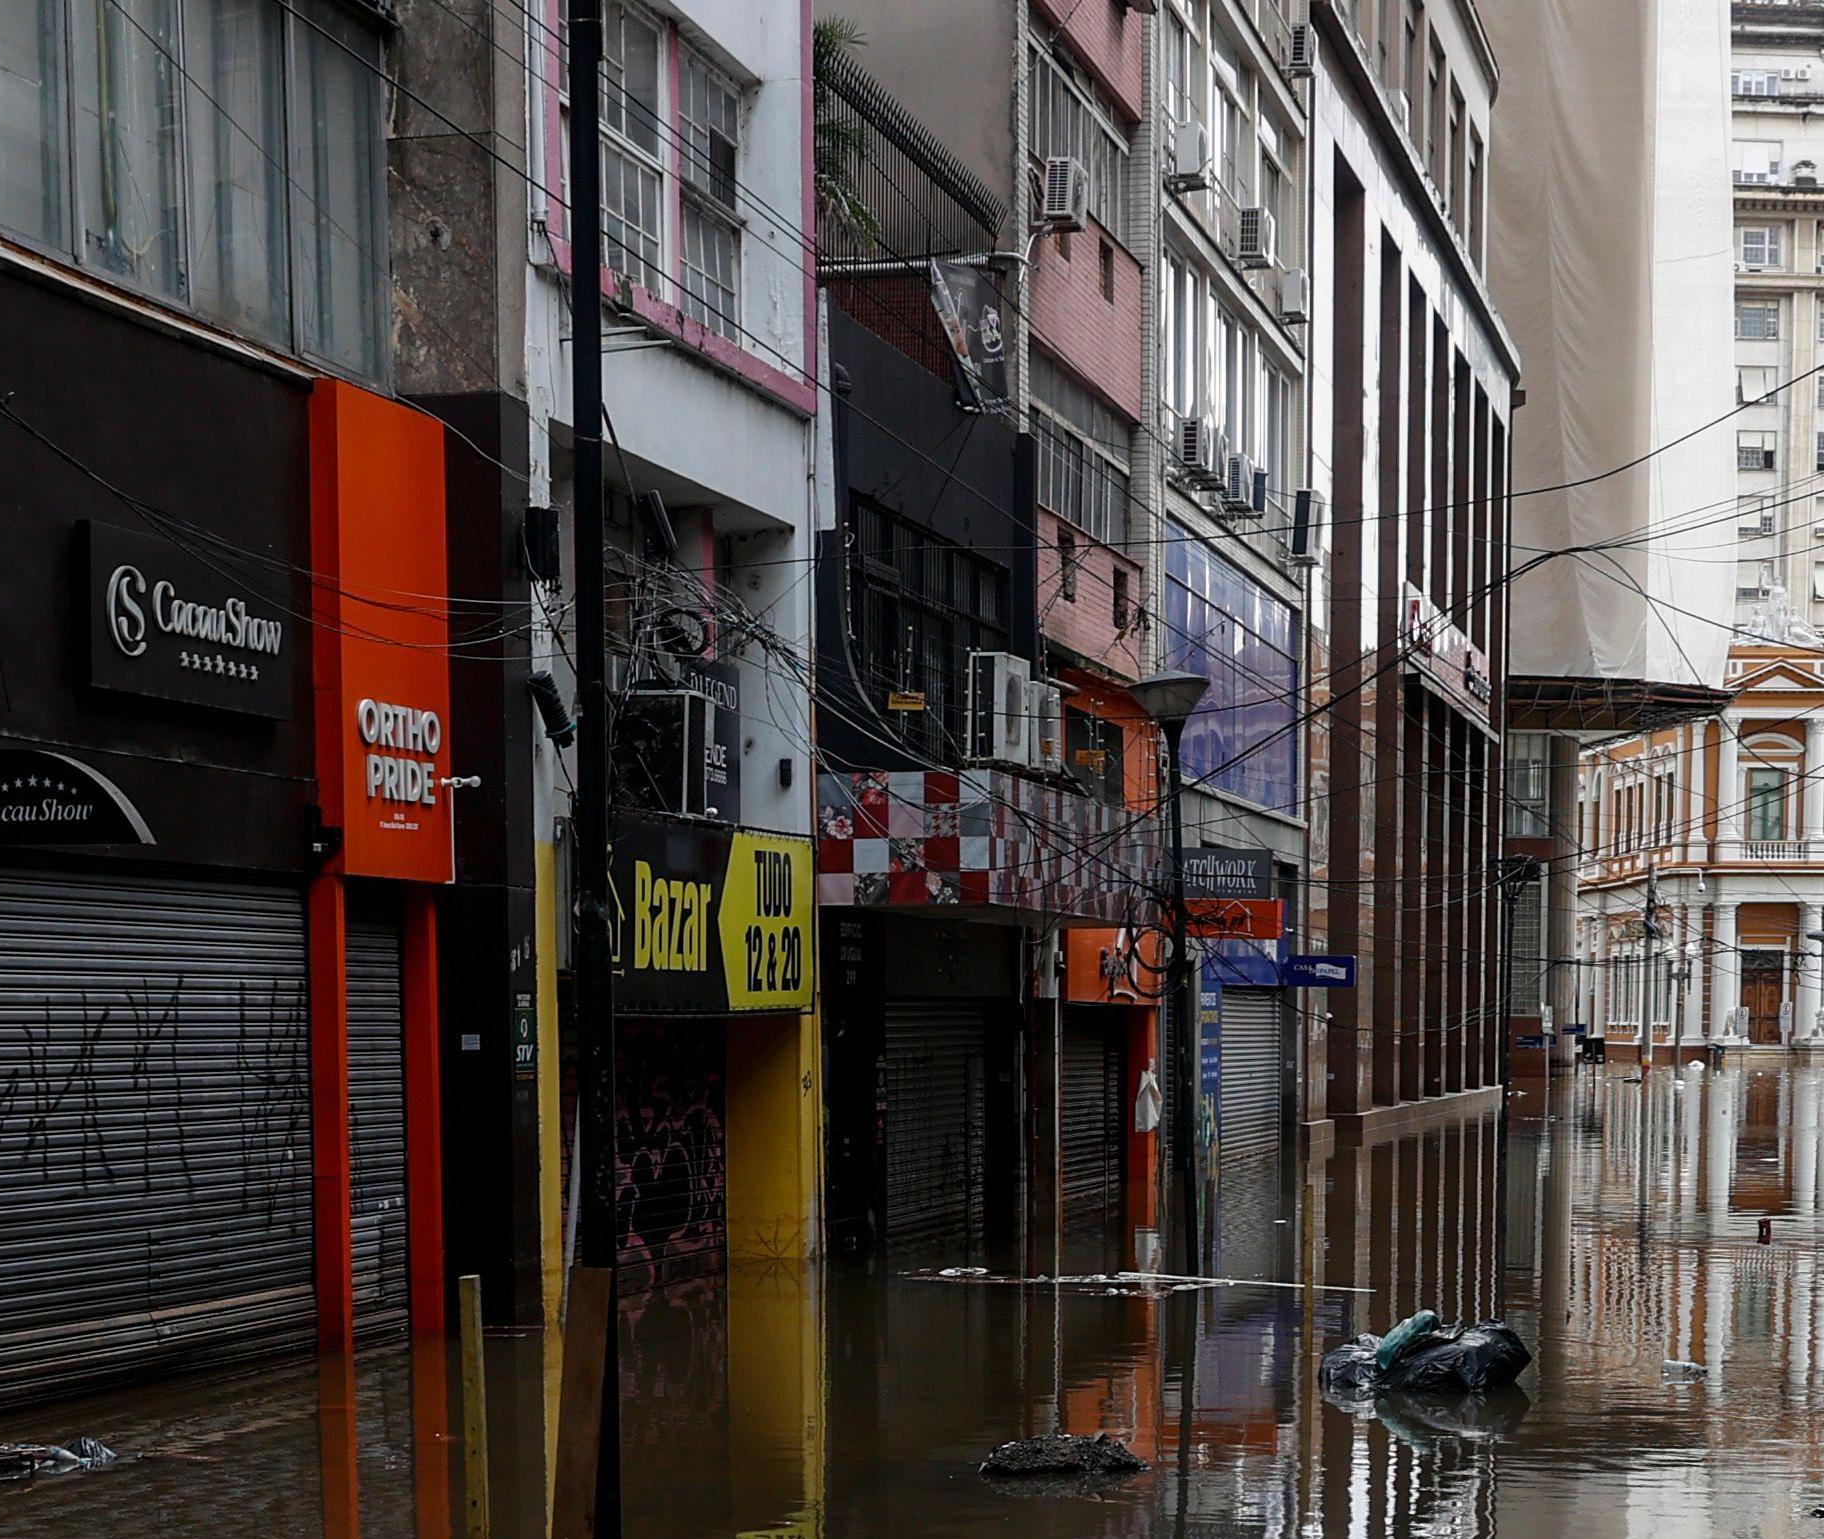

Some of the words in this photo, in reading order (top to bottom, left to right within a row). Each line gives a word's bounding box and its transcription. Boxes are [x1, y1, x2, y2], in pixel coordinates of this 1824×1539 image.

[358, 698, 441, 754] ORTHO
[366, 753, 436, 805] PRIDE
[754, 850, 791, 917] TUDO
[1182, 855, 1257, 892] ATCHWORK
[634, 859, 712, 972] Bazar
[745, 925, 762, 991] 12
[767, 933, 776, 991] &
[781, 926, 801, 991] 20
[515, 1044, 535, 1063] STV
